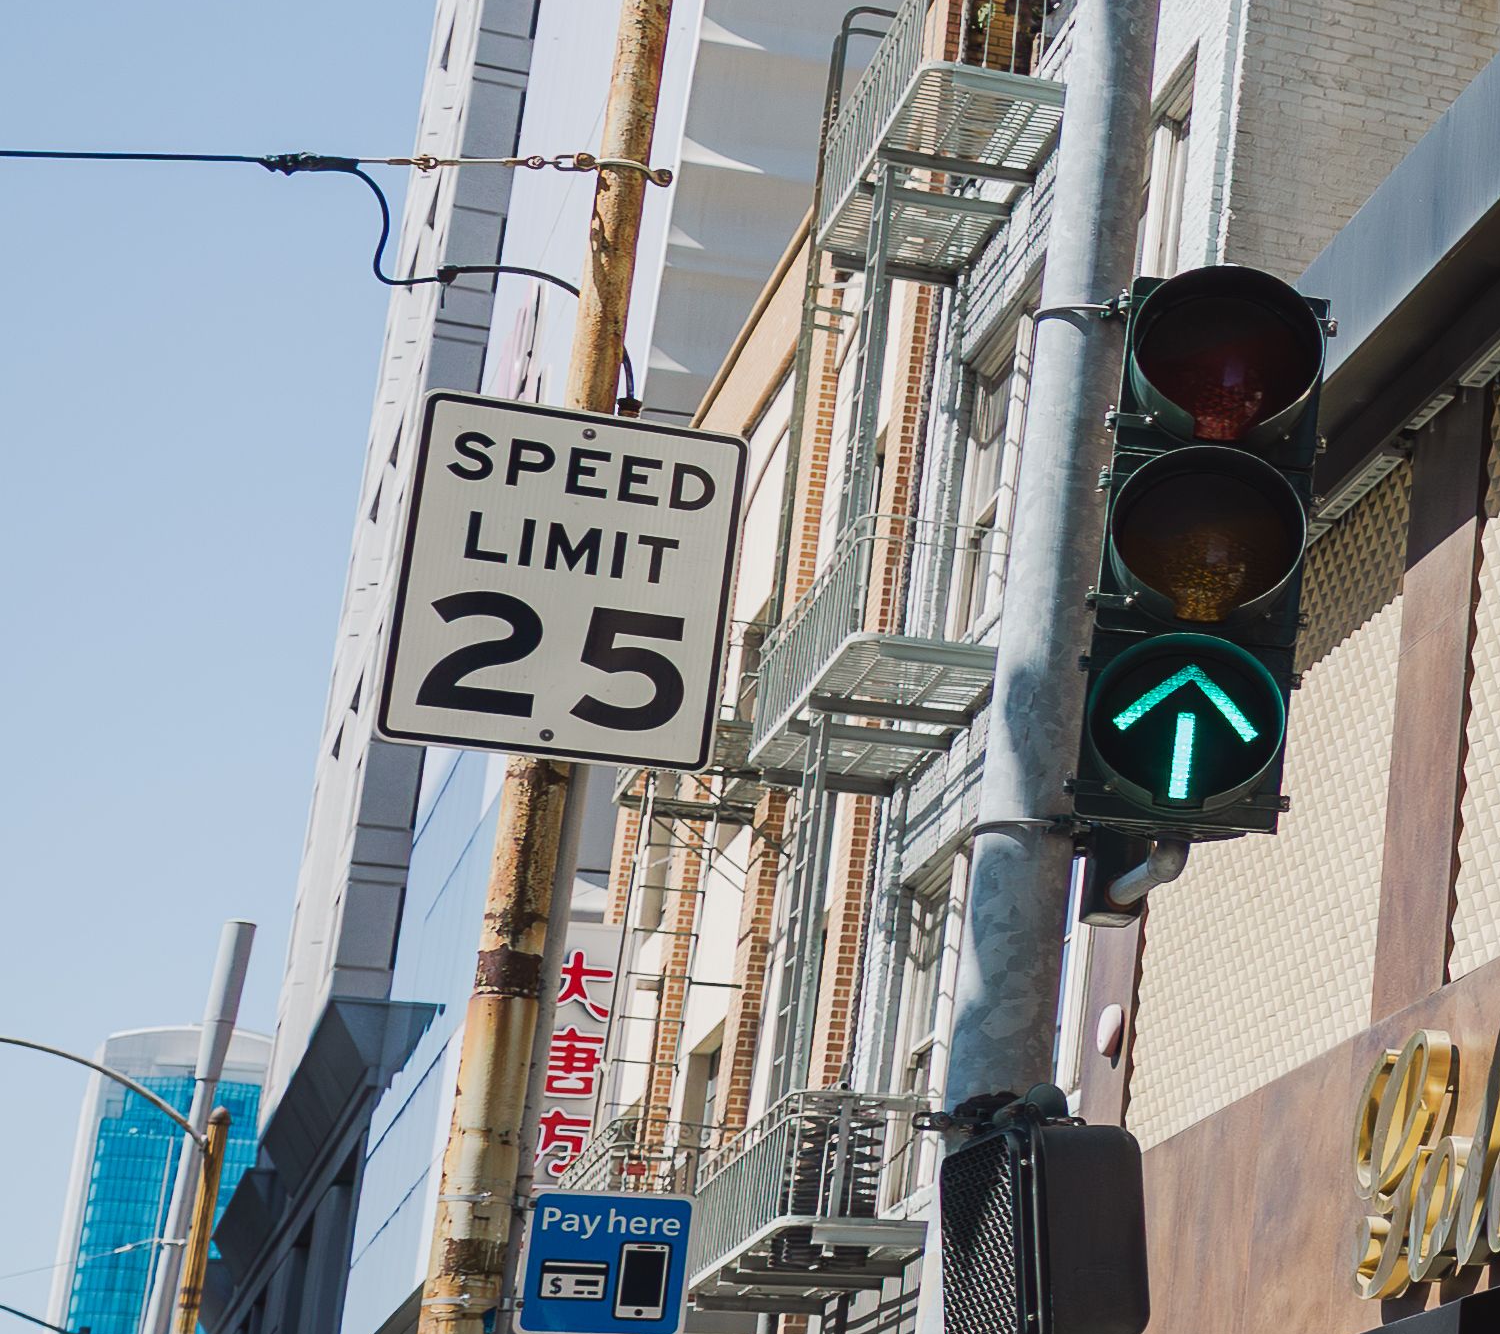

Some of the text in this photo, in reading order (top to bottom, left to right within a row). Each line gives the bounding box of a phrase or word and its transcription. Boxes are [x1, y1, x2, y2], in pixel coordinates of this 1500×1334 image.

[446, 431, 717, 511] SPEED
[464, 511, 680, 584] LIMIT
[415, 590, 686, 731] 25
[542, 1207, 681, 1239] Pay here
